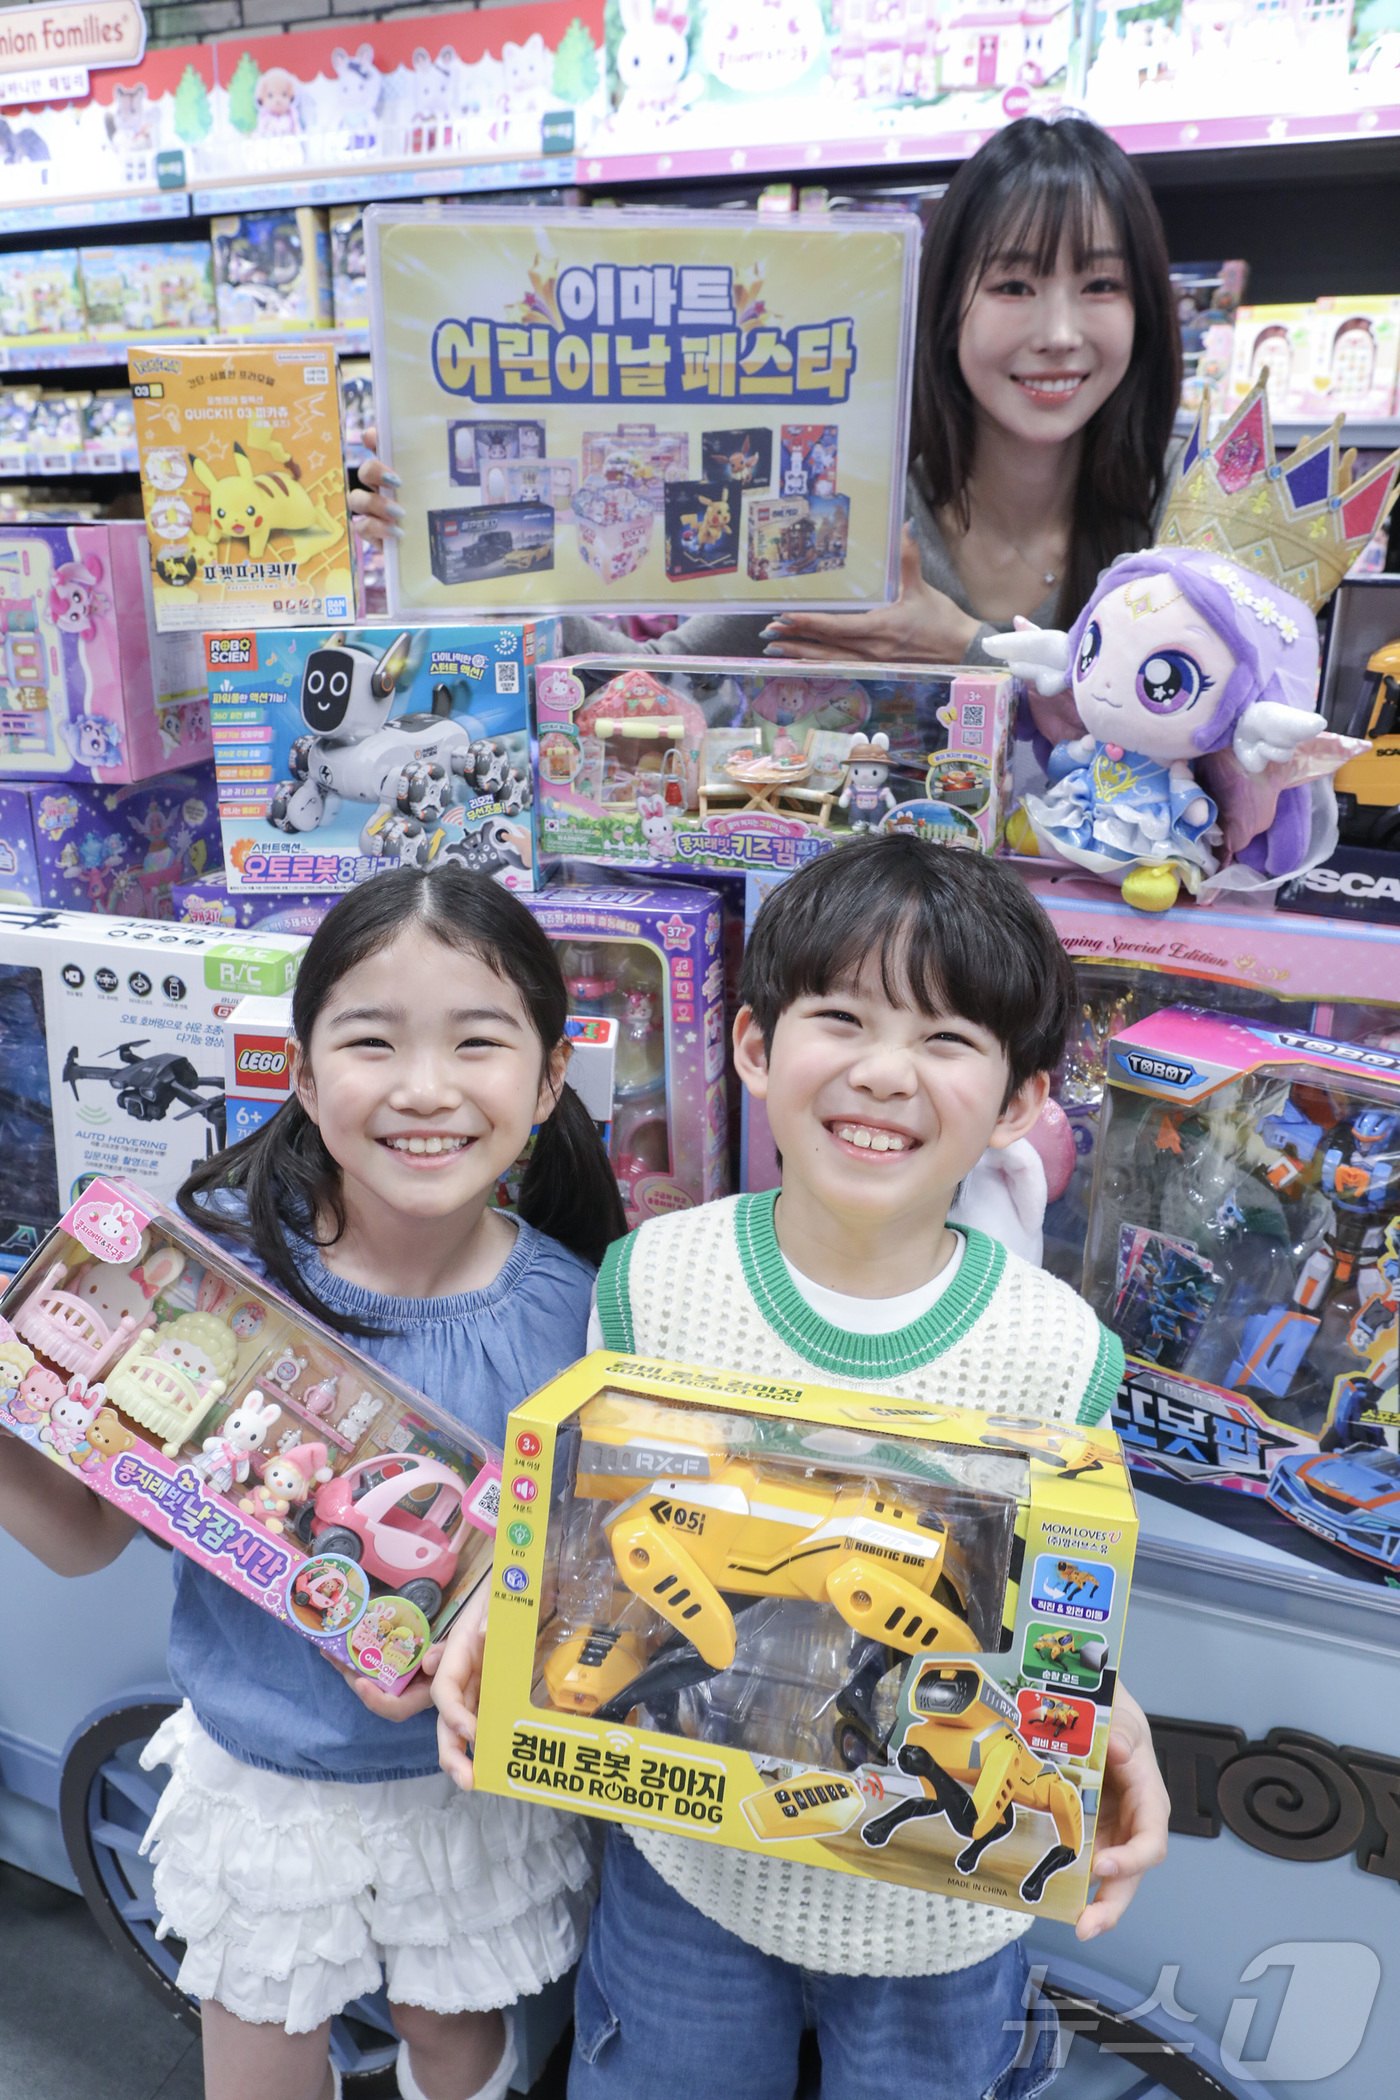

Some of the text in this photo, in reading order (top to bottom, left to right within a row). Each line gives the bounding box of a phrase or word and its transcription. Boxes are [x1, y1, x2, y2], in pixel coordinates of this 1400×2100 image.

[43, 15, 124, 50] Families
[558, 265, 734, 327] 이마트
[436, 320, 853, 398] 어린이날 페스타
[135, 386, 149, 397] 03
[236, 407, 253, 419] 03
[255, 406, 289, 418] 피카츄
[500, 637, 512, 648] 3+
[210, 651, 249, 664] SCIEN
[431, 652, 471, 664] 다이나믹한
[430, 663, 485, 680] 스턴트 액션!
[969, 691, 981, 702] 3+
[469, 794, 495, 808] 리모컨
[466, 803, 506, 821] 무선조종!
[251, 843, 301, 854] 스턴트액션
[680, 835, 731, 853] 콩지래빗
[113, 921, 268, 941] AIRCRAFT
[667, 926, 687, 938] 37+
[1106, 935, 1167, 956] Special
[1168, 942, 1229, 968] Edition
[120, 1014, 224, 1036] 오토 호버링으로 쉬운 조종
[176, 1033, 224, 1048] 다기능 영상
[237, 1049, 288, 1075] LEGO
[1129, 1056, 1192, 1085] TOBOT
[236, 1107, 263, 1125] 6+
[75, 1130, 168, 1151] AUTO HOVERING
[84, 1150, 159, 1170] 입문자용 촬영드론
[74, 1219, 126, 1262] 콩지래빗&친구들
[756, 1391, 801, 1403] DOG
[522, 1437, 537, 1452] 3+
[526, 1461, 541, 1472] 이상
[635, 1451, 701, 1477] RX-F
[512, 1504, 534, 1515] 사운드
[118, 1458, 286, 1585] 콩지래빗 낮잠 시간
[1041, 1522, 1072, 1536] MOM
[1073, 1527, 1107, 1542] LOVES
[511, 1549, 526, 1558] LED
[855, 1541, 926, 1568] ROBOTIC DOG
[1037, 1600, 1104, 1621] 직진 & 회전 이동
[1061, 1673, 1080, 1686] 모드
[1032, 1736, 1050, 1750] 경비
[1050, 1740, 1069, 1753] 모드
[511, 1732, 727, 1804] 경비 로봇 강아지
[506, 1761, 584, 1794] GUARD
[673, 1801, 724, 1825] DOG
[947, 1877, 1008, 1897] MADE IN CHINA
